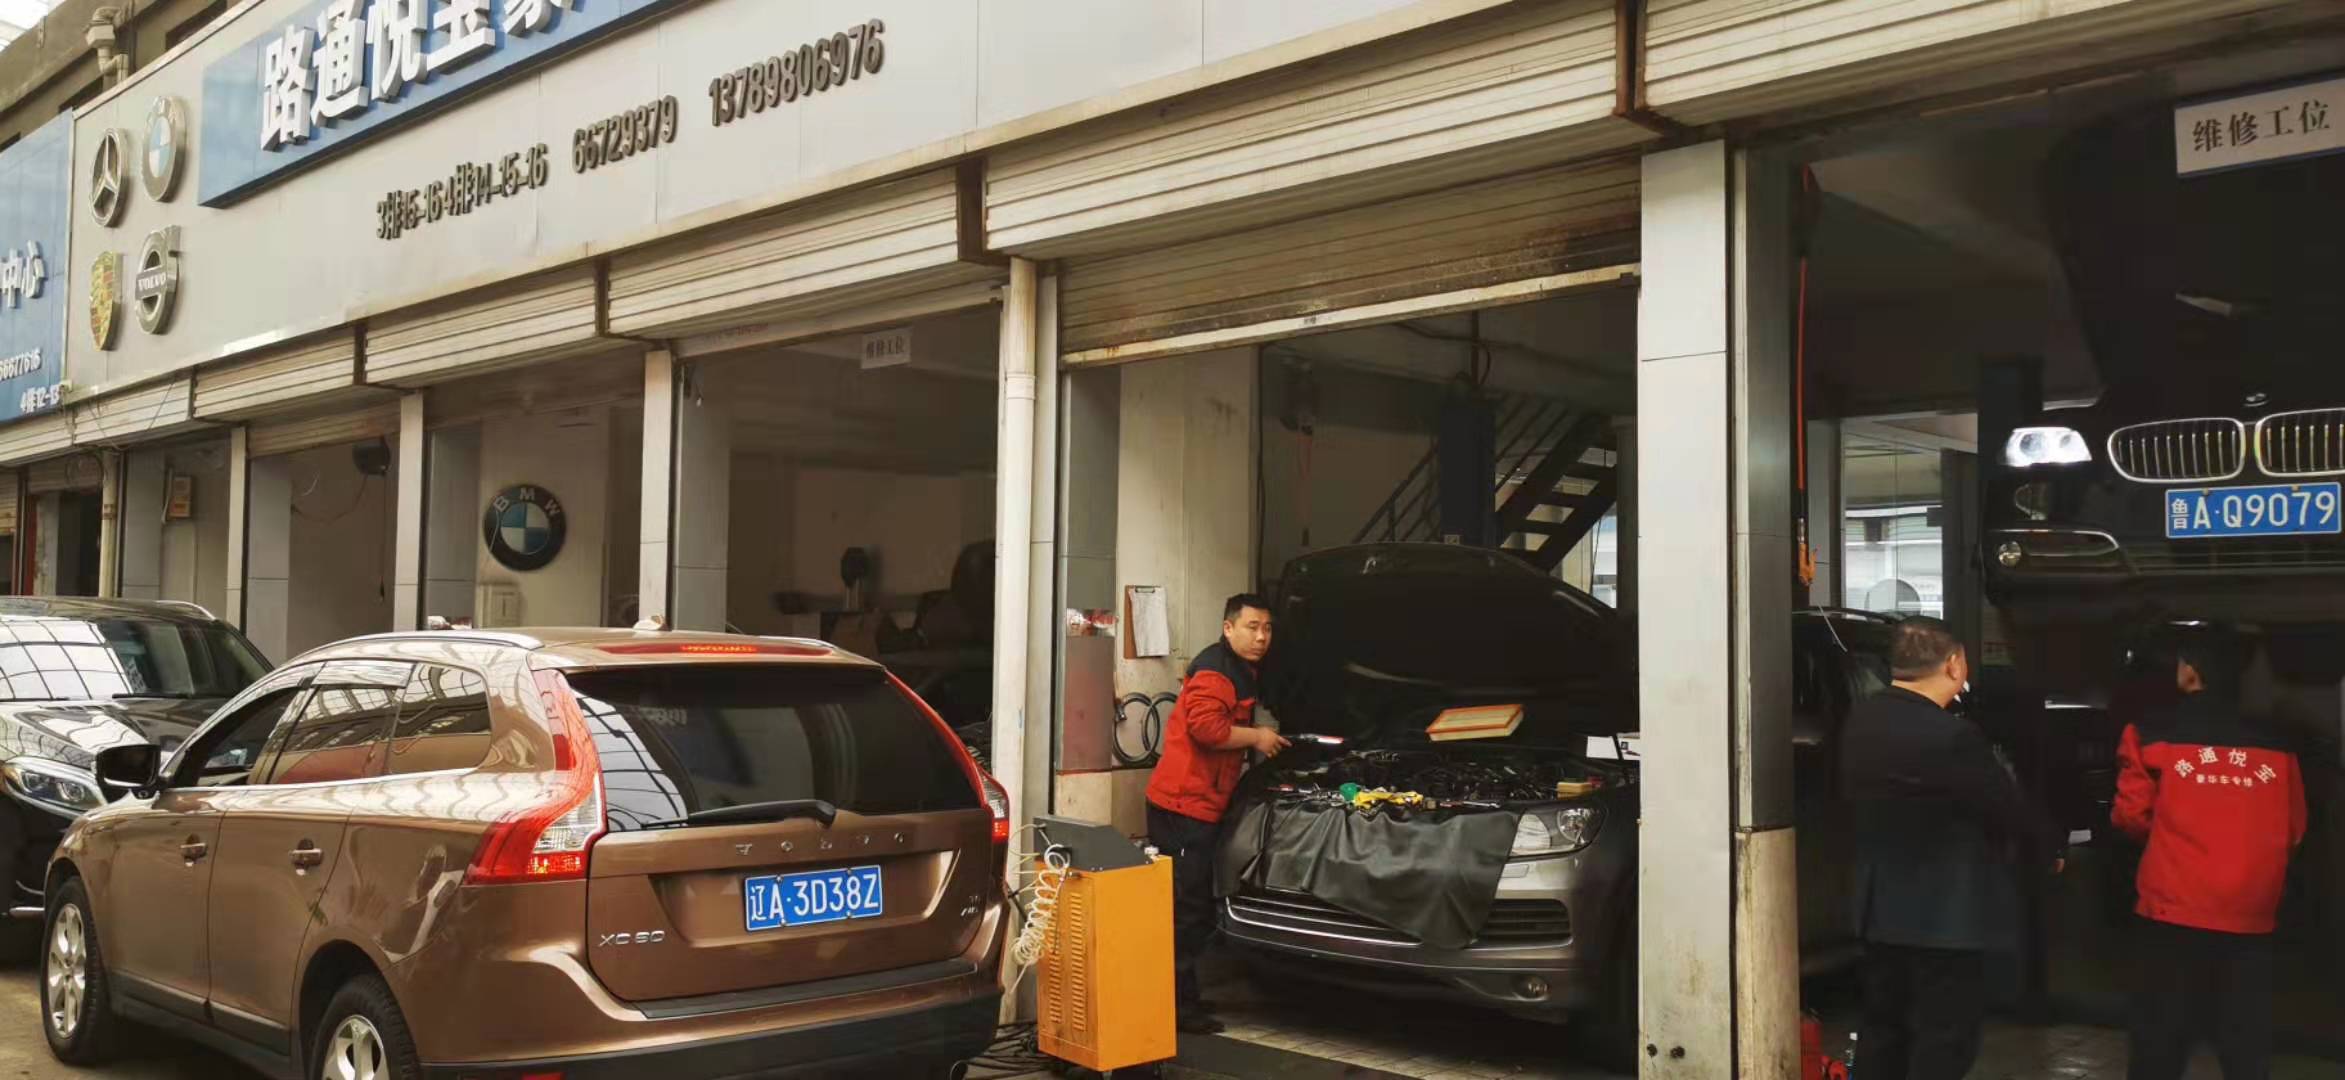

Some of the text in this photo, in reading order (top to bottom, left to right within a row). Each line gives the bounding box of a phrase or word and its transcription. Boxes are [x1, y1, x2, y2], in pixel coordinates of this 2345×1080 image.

[572, 95, 679, 174] 66729379
[708, 18, 885, 127] 13789806976
[2192, 99, 2330, 152] 维修工位
[138, 272, 167, 292] VOLVO
[493, 487, 560, 515] BMW
[2171, 491, 2336, 529] 鲁A·Q9079
[2174, 747, 2277, 785] 路通悦宝
[750, 874, 880, 921] 辽A·3D38Z
